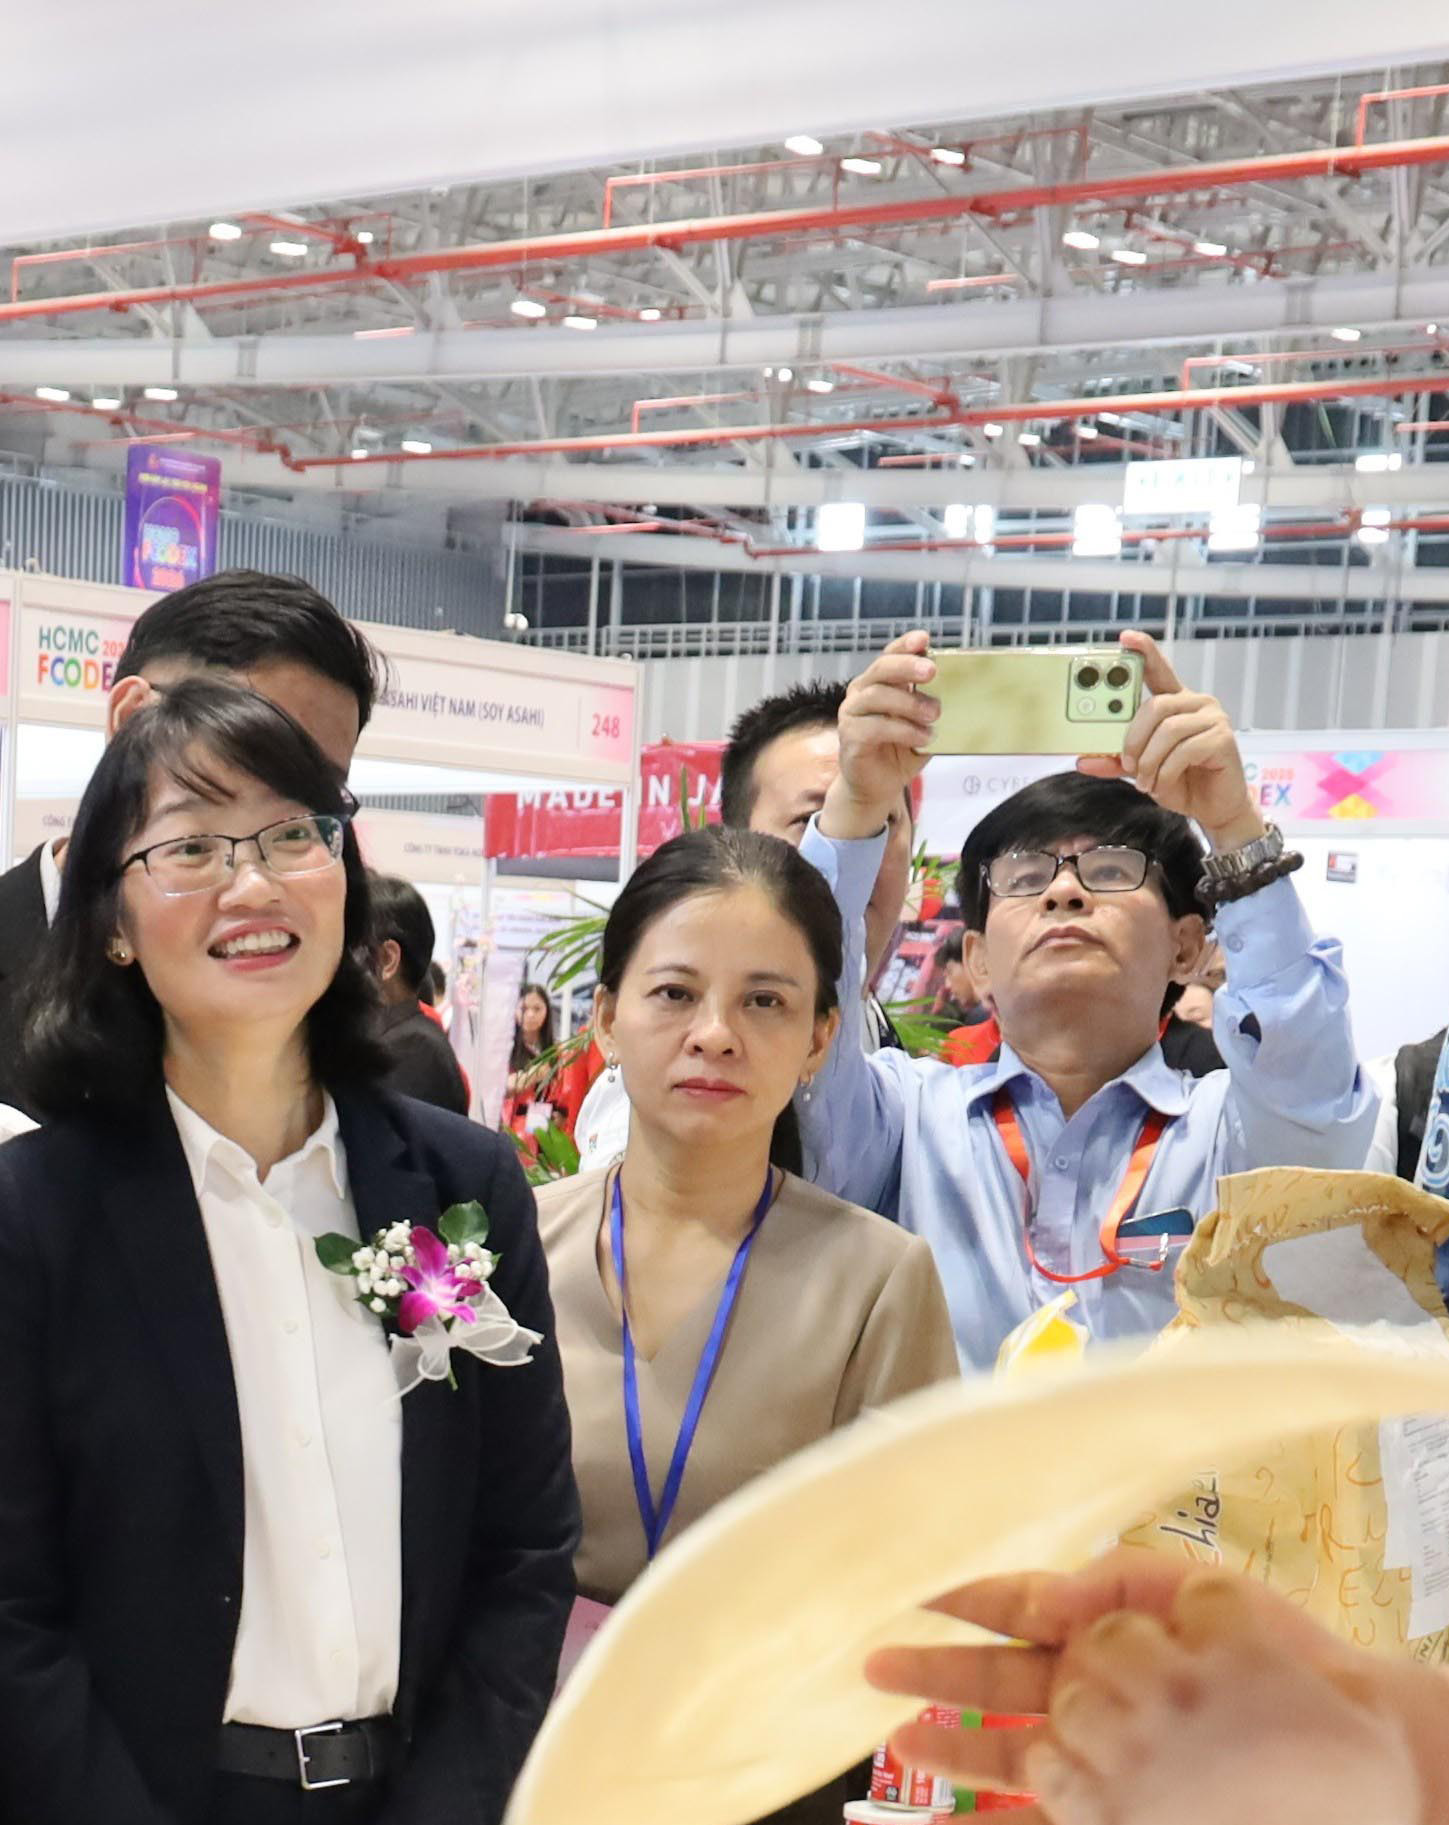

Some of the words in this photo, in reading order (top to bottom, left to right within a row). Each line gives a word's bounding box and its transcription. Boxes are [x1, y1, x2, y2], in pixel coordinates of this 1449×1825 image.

[38, 624, 99, 655] HCMC
[102, 640, 128, 657] 202
[448, 697, 476, 717] NAM
[591, 713, 621, 739] 248
